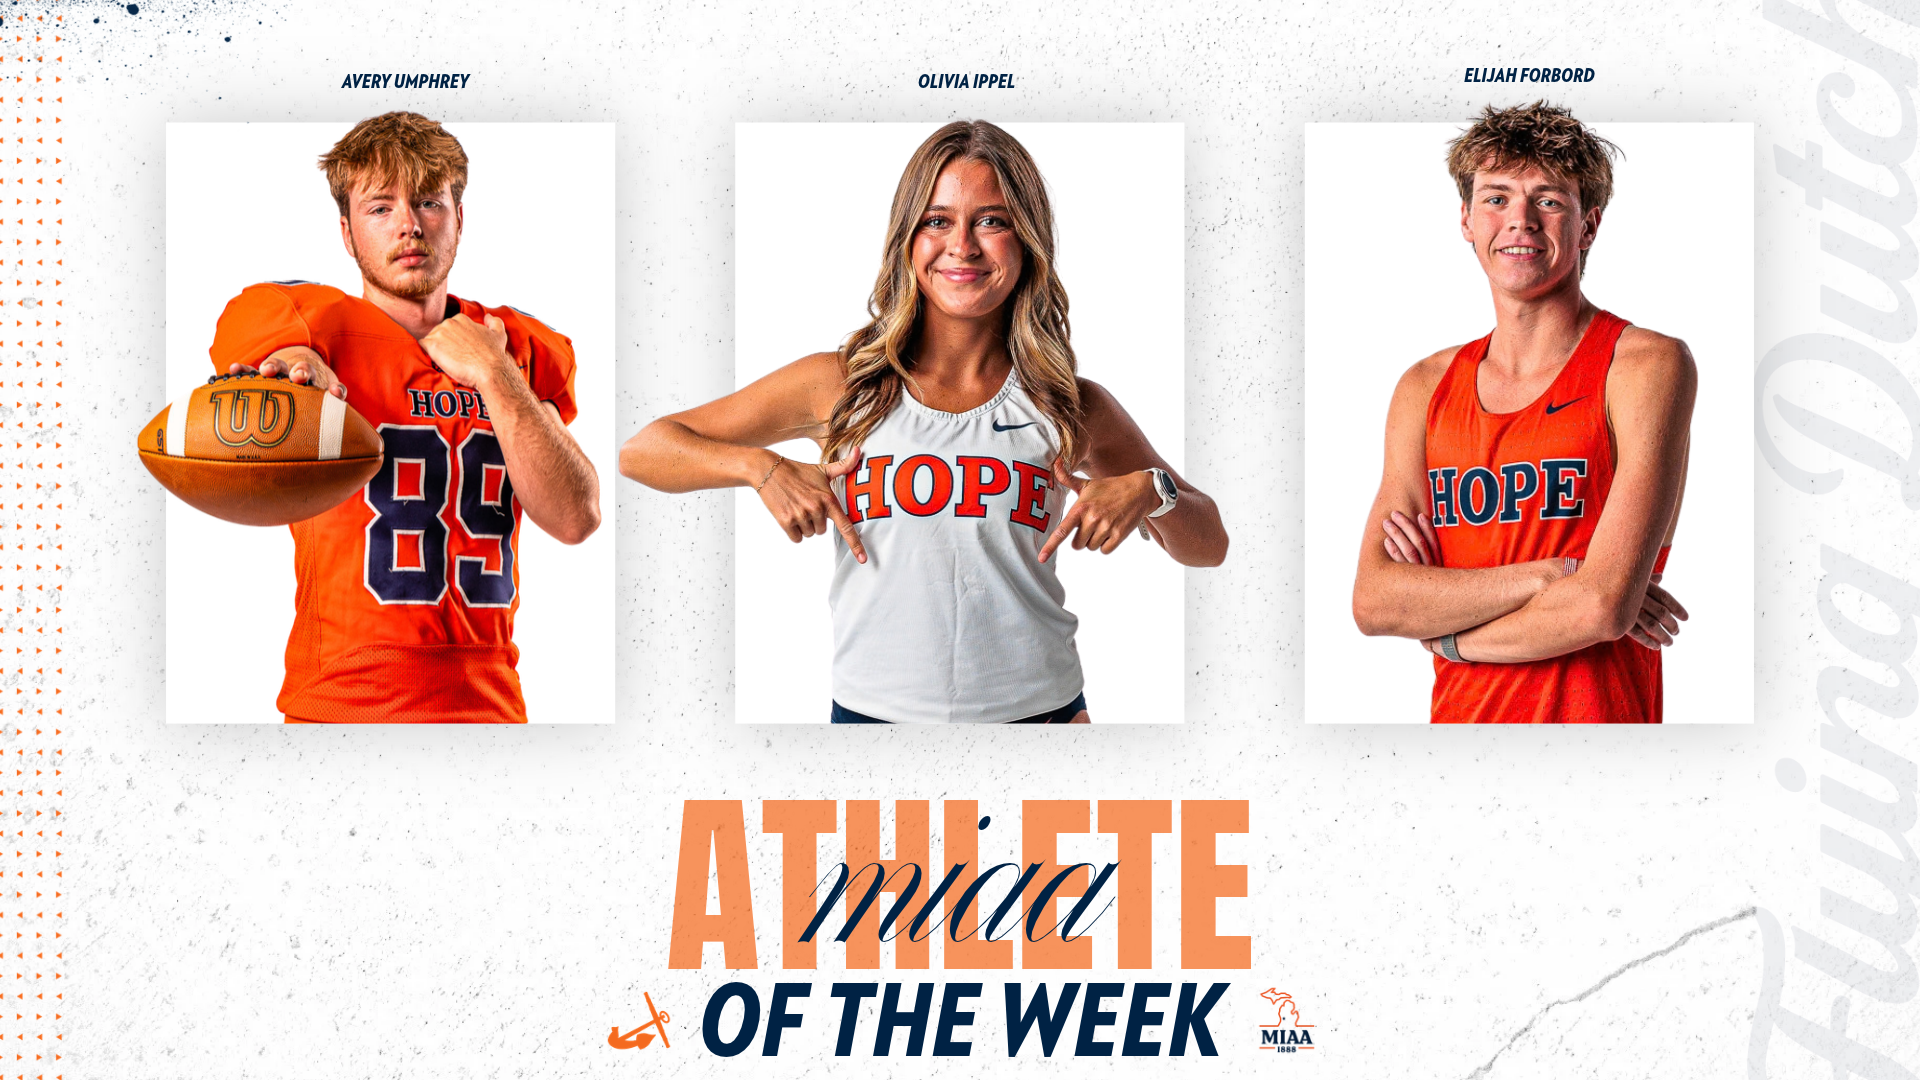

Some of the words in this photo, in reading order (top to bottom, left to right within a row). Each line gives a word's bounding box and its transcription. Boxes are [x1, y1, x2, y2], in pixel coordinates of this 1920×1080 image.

[209, 388, 296, 448] W
[363, 422, 517, 609] 89
[845, 453, 1055, 534] HOPE
[1428, 458, 1588, 528] HOPE
